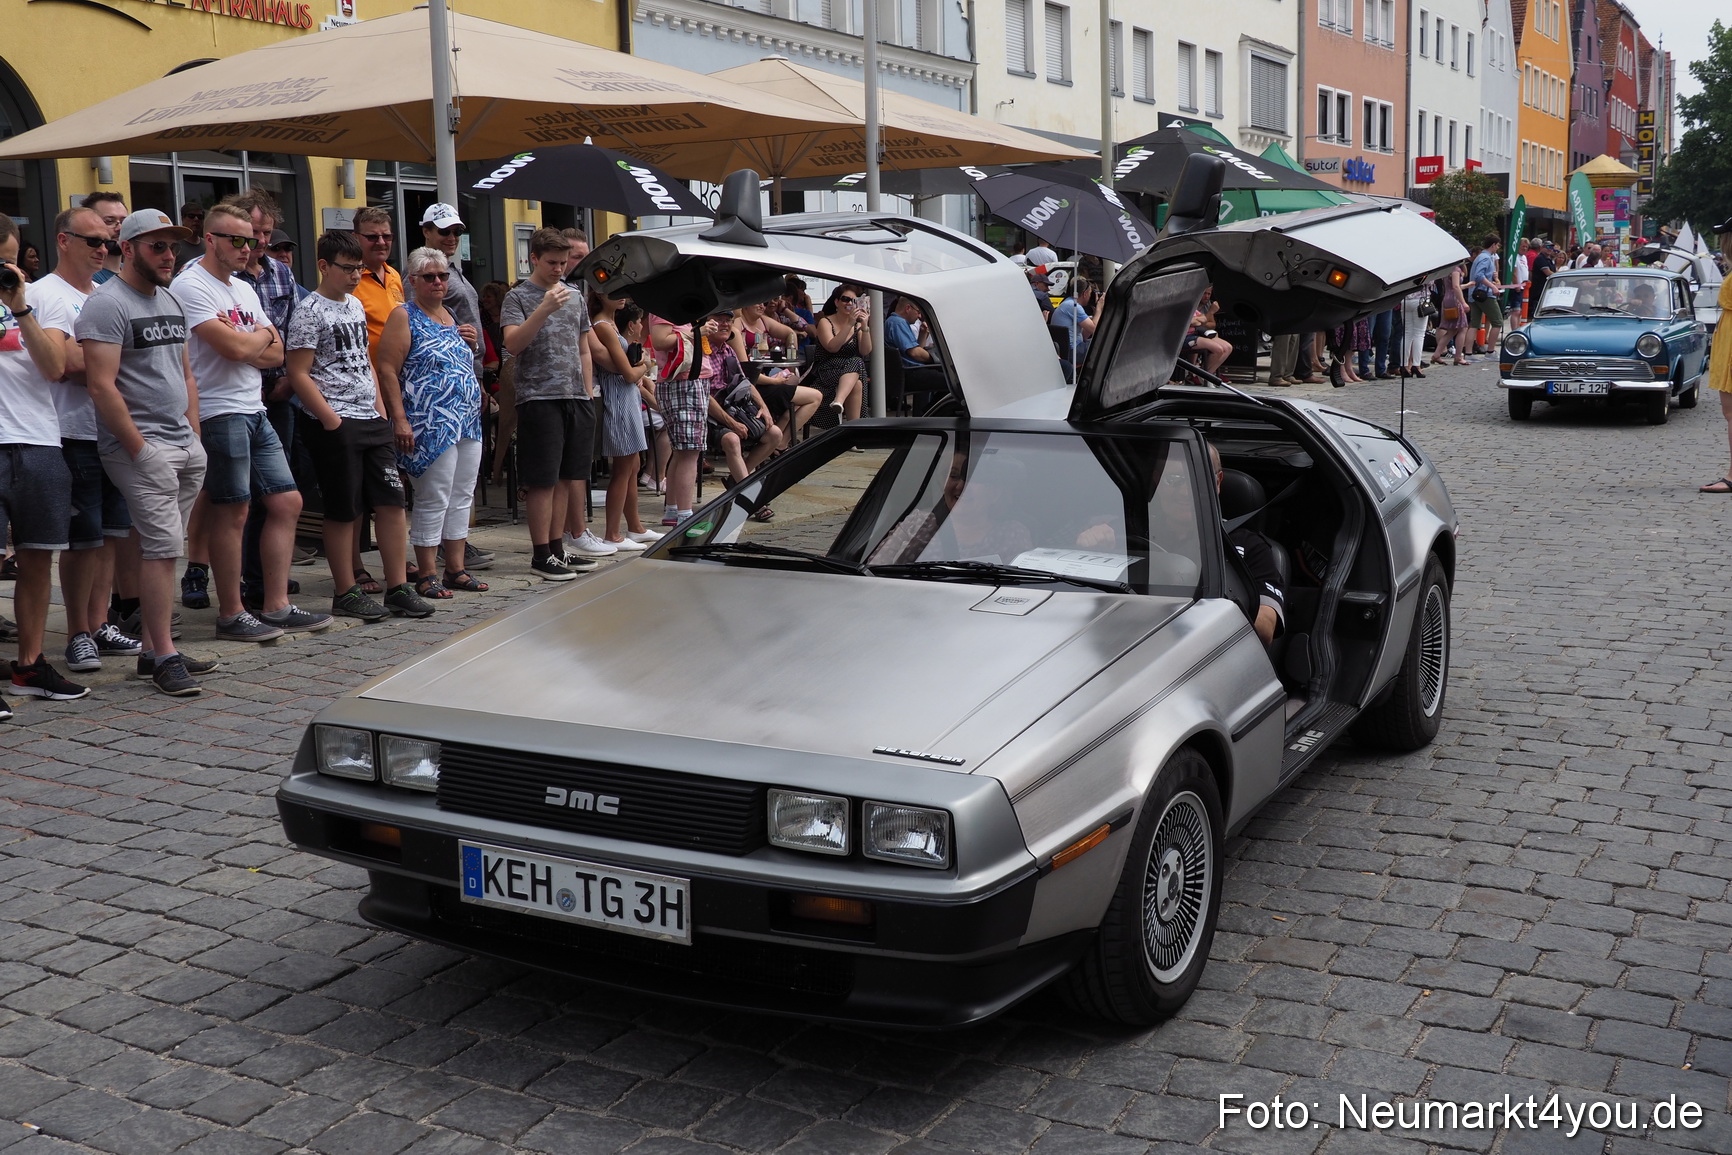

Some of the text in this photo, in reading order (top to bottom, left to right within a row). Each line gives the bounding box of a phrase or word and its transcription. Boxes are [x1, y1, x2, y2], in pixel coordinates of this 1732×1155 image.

[230, 0, 313, 29] RATHAUS
[182, 76, 329, 104] Neumarkter
[124, 88, 329, 127] Lammsbräu
[1638, 112, 1654, 193] HOTEL
[472, 154, 536, 190] now
[1419, 165, 1439, 173] WITT
[629, 165, 682, 211] now
[142, 319, 186, 343] adidas
[1553, 383, 1608, 394] SUL F 12H
[469, 877, 477, 889] D
[483, 854, 684, 930] KEH TG 3H
